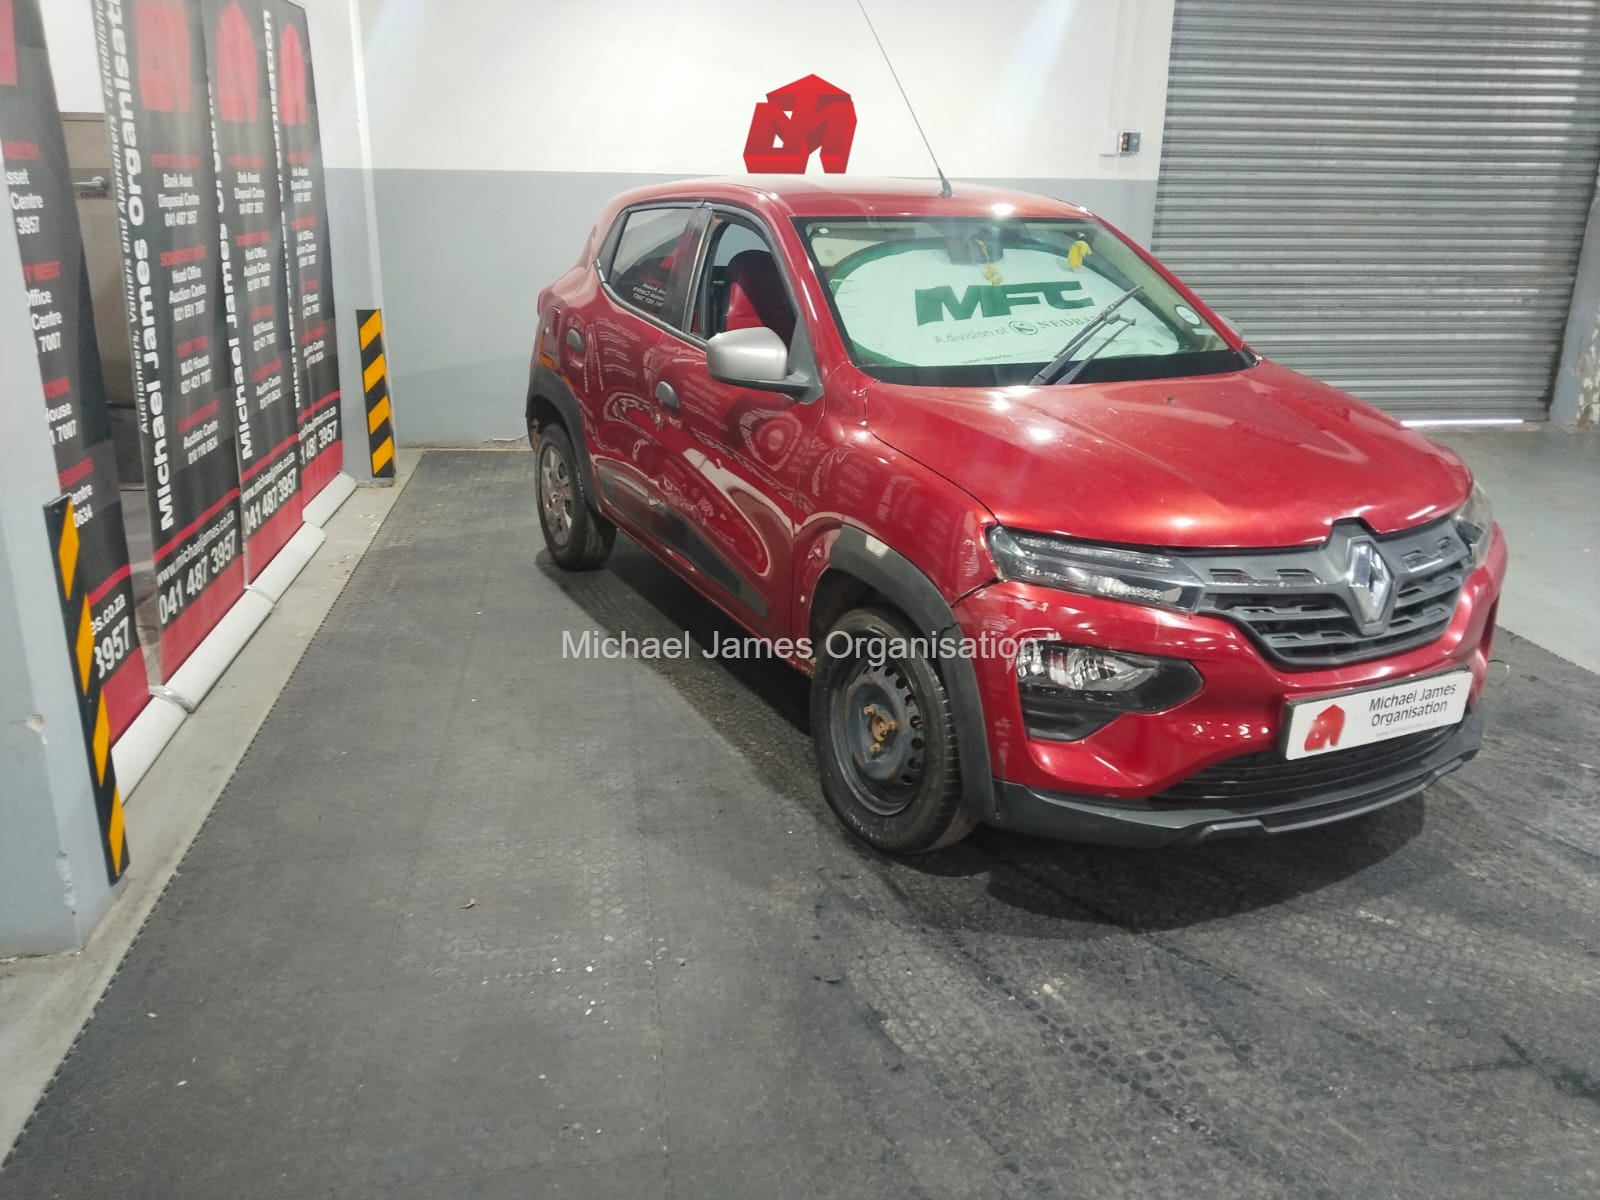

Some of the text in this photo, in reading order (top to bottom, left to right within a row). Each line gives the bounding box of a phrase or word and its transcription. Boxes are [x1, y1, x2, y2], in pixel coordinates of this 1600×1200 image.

[31, 311, 63, 330] Centre
[134, 239, 159, 368] James
[914, 280, 1095, 327] MFC
[946, 327, 994, 343] division
[318, 419, 338, 449] 3957
[146, 380, 174, 531] Michael
[262, 485, 278, 517] 487
[278, 467, 297, 502] 3957
[159, 528, 236, 625] 041 487 3957
[1369, 683, 1457, 712] Michael James
[1371, 699, 1448, 727] Organisation
